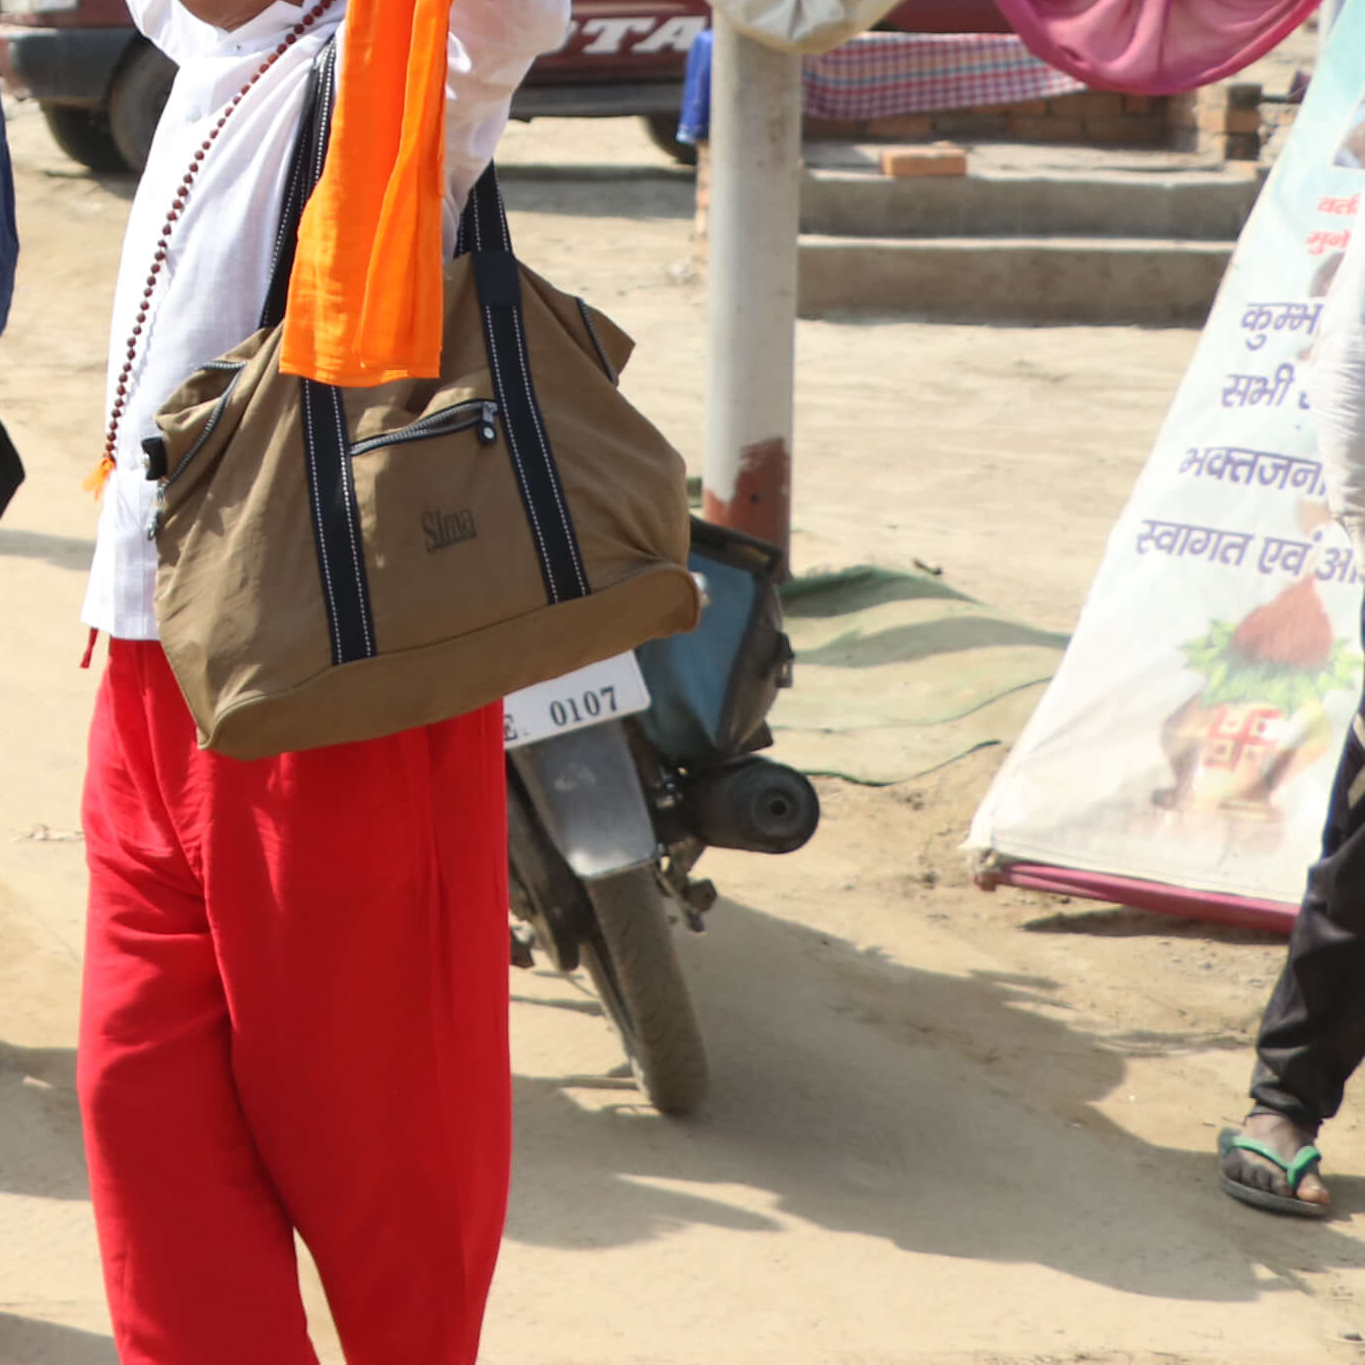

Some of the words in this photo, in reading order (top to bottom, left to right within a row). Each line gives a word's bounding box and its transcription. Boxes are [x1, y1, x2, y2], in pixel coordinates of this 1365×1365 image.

[567, 15, 707, 54] TA
[1136, 518, 1254, 567] स्वागत
[1257, 529, 1323, 577] एवं
[550, 685, 618, 727] 0107
